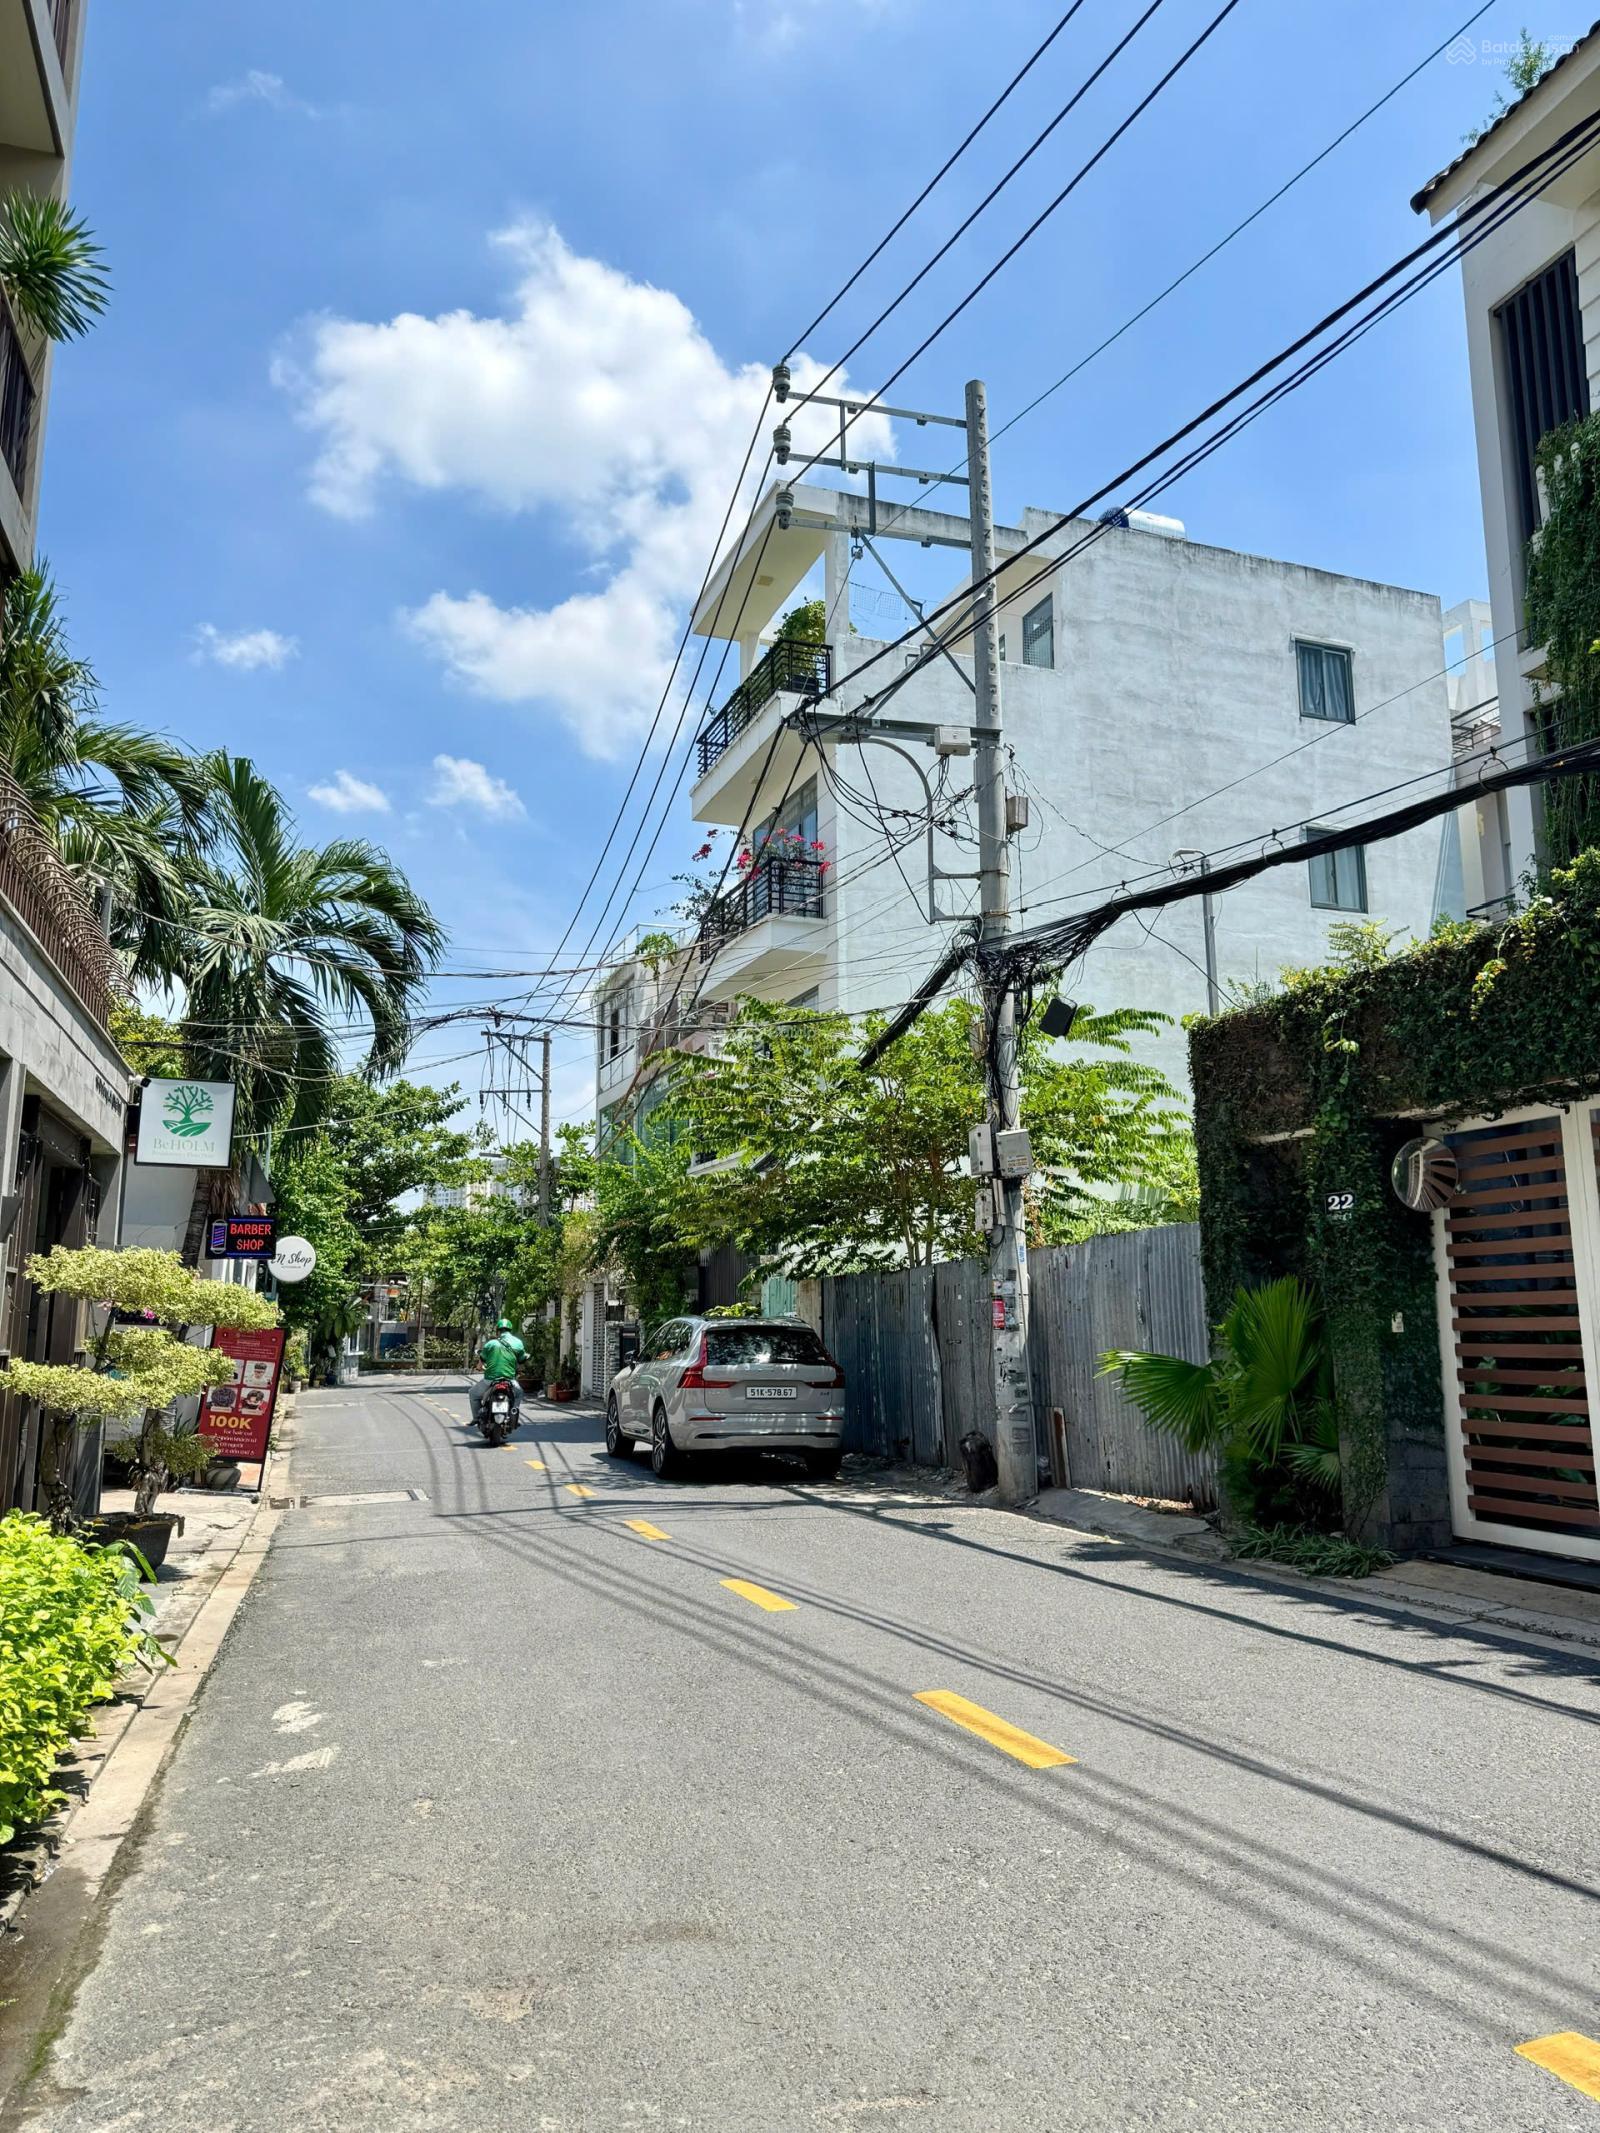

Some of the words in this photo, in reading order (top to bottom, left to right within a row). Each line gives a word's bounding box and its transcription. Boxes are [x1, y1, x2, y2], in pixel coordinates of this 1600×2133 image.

[1328, 1194, 1354, 1210] 22
[230, 1223, 272, 1236] BARBER
[236, 1239, 265, 1251] SHOP
[288, 1250, 313, 1267] Shop
[750, 1388, 793, 1397] 51K-578.67
[209, 1414, 253, 1430] 100K
